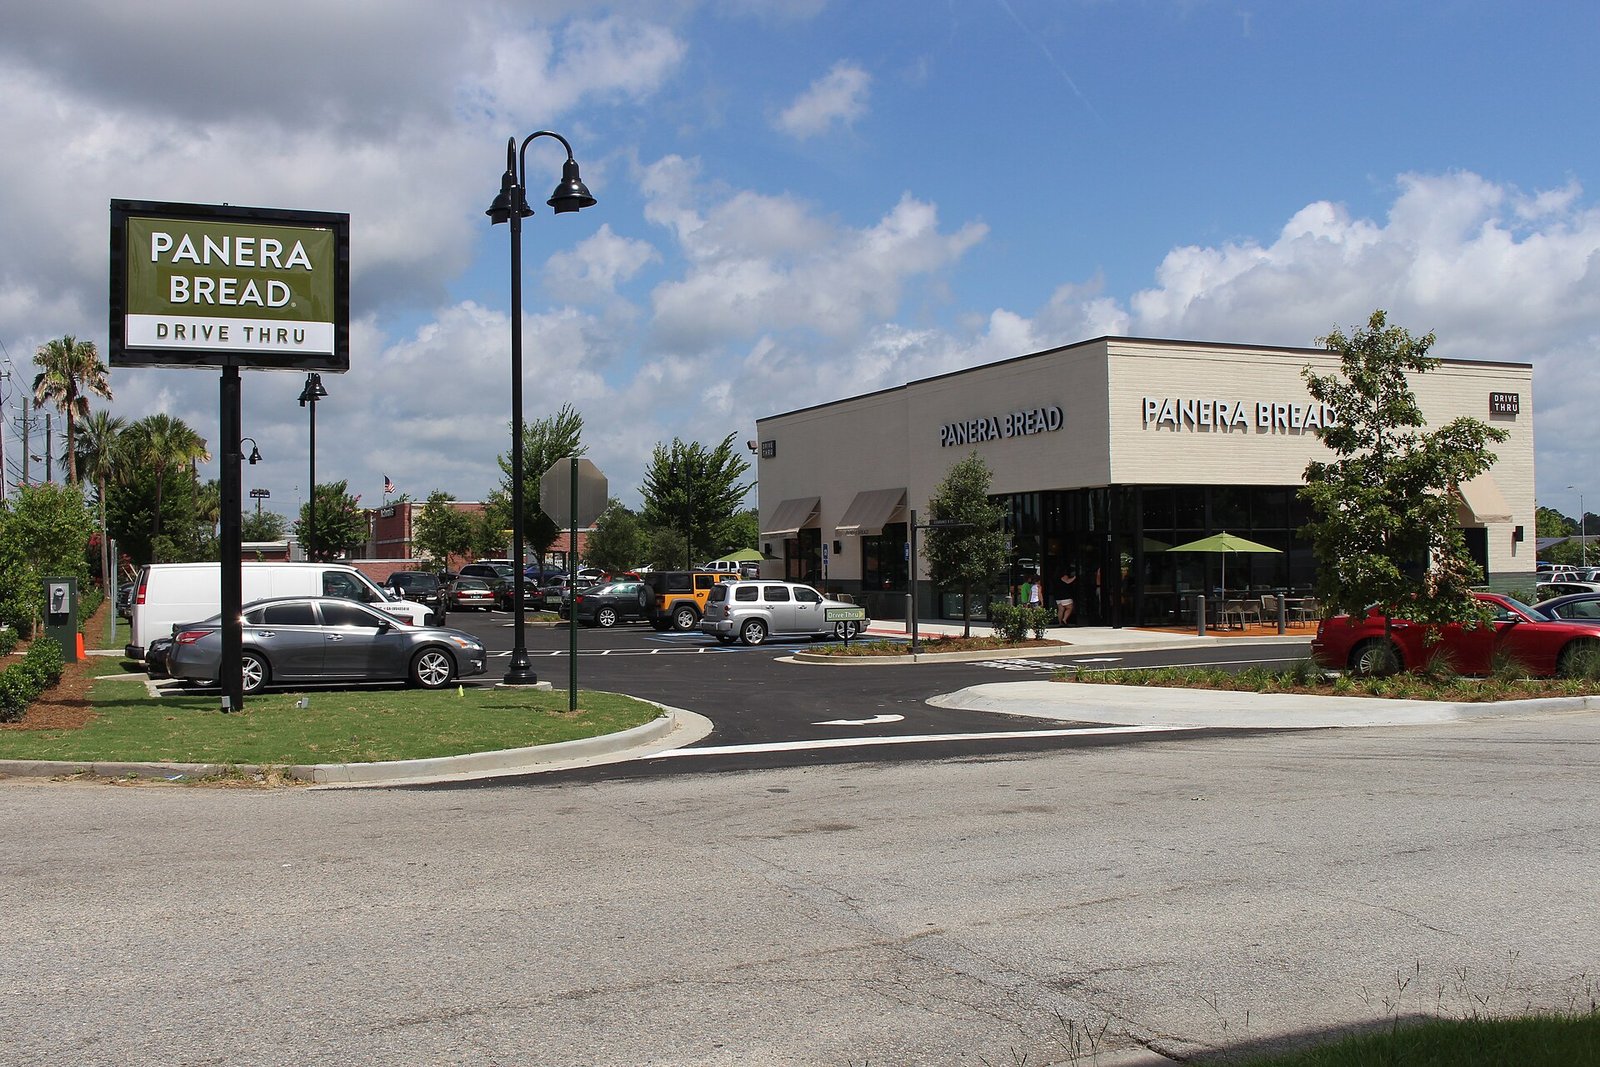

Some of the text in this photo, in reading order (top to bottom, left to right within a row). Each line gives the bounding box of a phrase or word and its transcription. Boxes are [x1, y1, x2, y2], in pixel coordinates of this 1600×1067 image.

[151, 232, 313, 270] PANERA
[170, 275, 291, 308] BREAD
[157, 323, 306, 343] DRIVE THRU
[1143, 397, 1337, 429] PANERA BREAD
[1494, 394, 1517, 402] DRIVE
[1494, 403, 1518, 412] THRU
[940, 406, 1064, 447] PANERA BREAD
